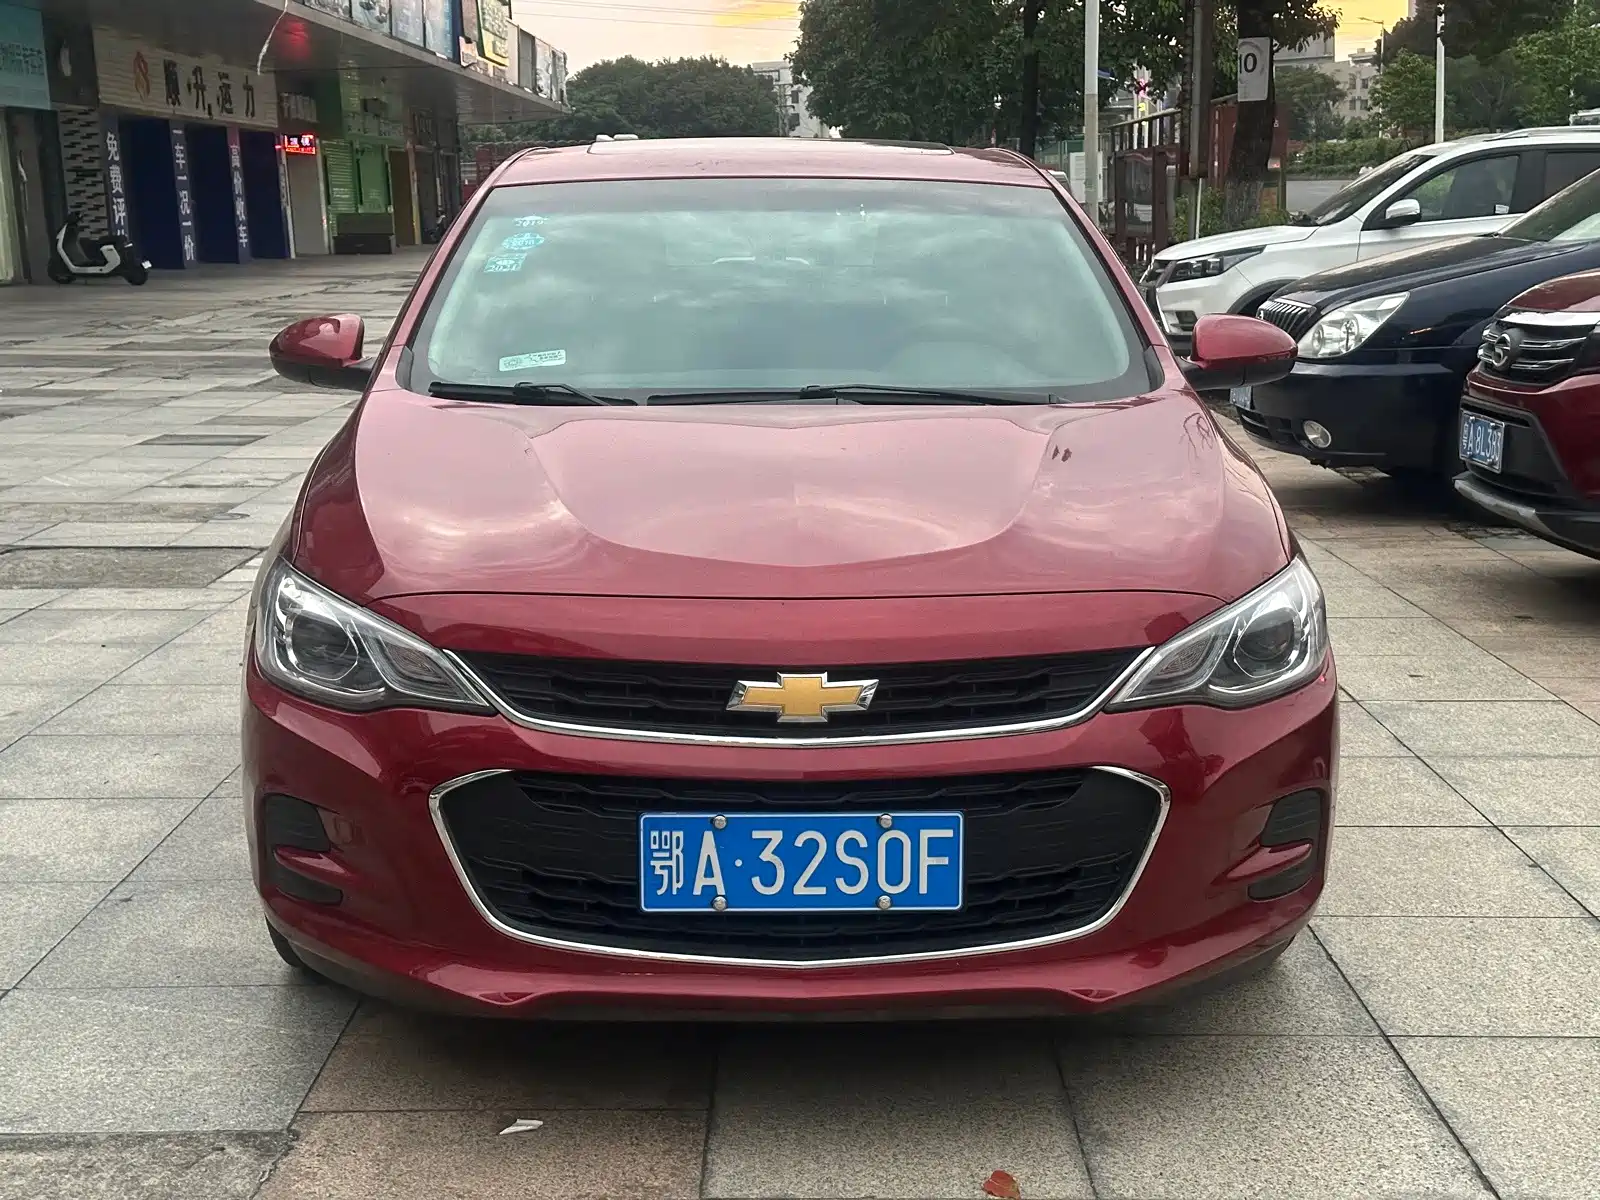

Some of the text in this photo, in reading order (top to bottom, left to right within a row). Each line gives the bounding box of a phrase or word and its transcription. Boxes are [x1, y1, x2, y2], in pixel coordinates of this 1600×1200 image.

[172, 129, 195, 260] 一车一况一价
